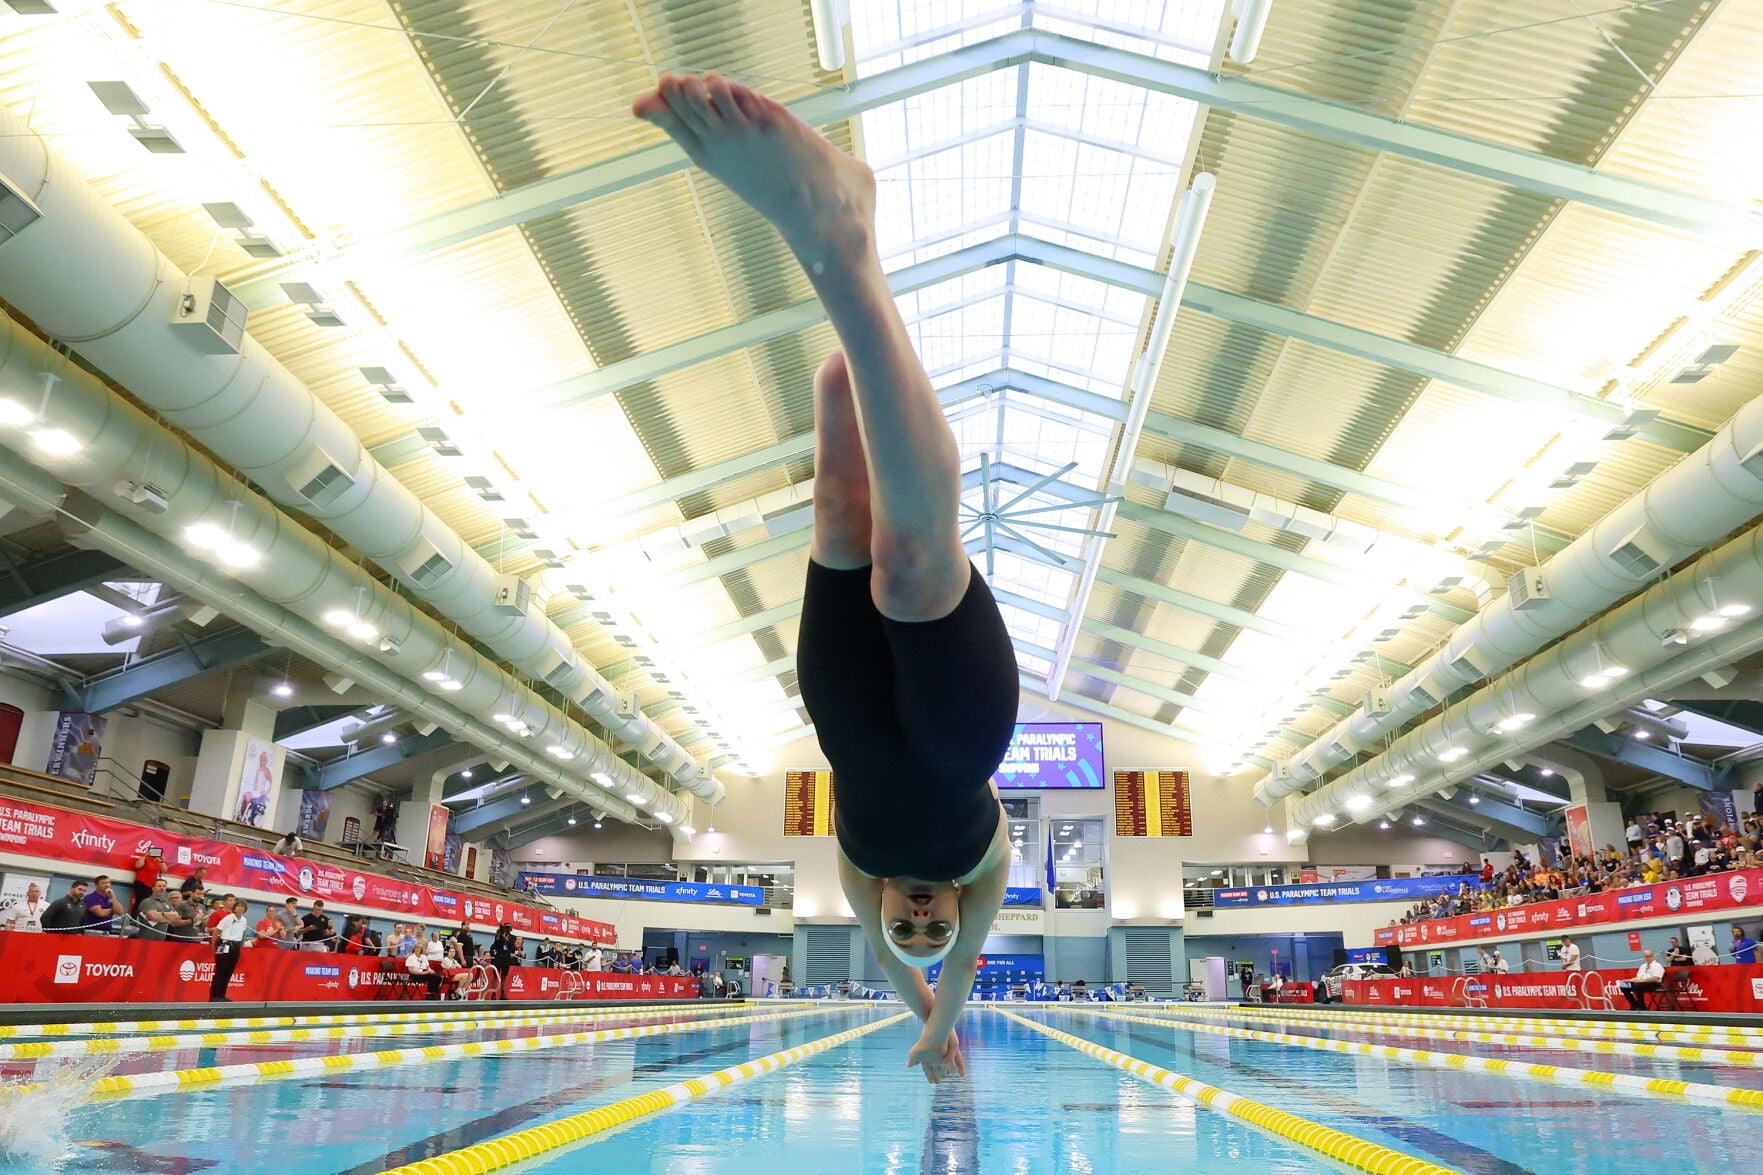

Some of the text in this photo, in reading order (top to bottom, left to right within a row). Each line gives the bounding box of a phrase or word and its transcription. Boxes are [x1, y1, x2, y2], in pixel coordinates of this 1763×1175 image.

[1016, 733, 1076, 745] PARALYMPIC
[1004, 747, 1077, 761] EAM TRIALS
[13, 809, 56, 826] PARALYMPIC
[0, 818, 54, 838] TEAM TRIALS
[71, 829, 116, 853] xfinity
[192, 854, 221, 866] TOYOTA
[591, 882, 628, 891] PARALYMPIC
[629, 884, 645, 893] TEAM
[645, 886, 665, 894] TRIALS
[675, 887, 698, 896] xfinity
[1270, 887, 1360, 899] U.S. PARALYMPIC TEAM TRIALS
[999, 913, 1038, 921] HEPPARD
[85, 963, 134, 977] TOYOTA
[196, 963, 216, 972] VISIT
[194, 973, 245, 982] LAUALE
[361, 972, 371, 985] U.S.
[1502, 985, 1512, 997] U.S.
[1512, 985, 1543, 997] PARALYMPIC
[1542, 985, 1557, 996] TEAM
